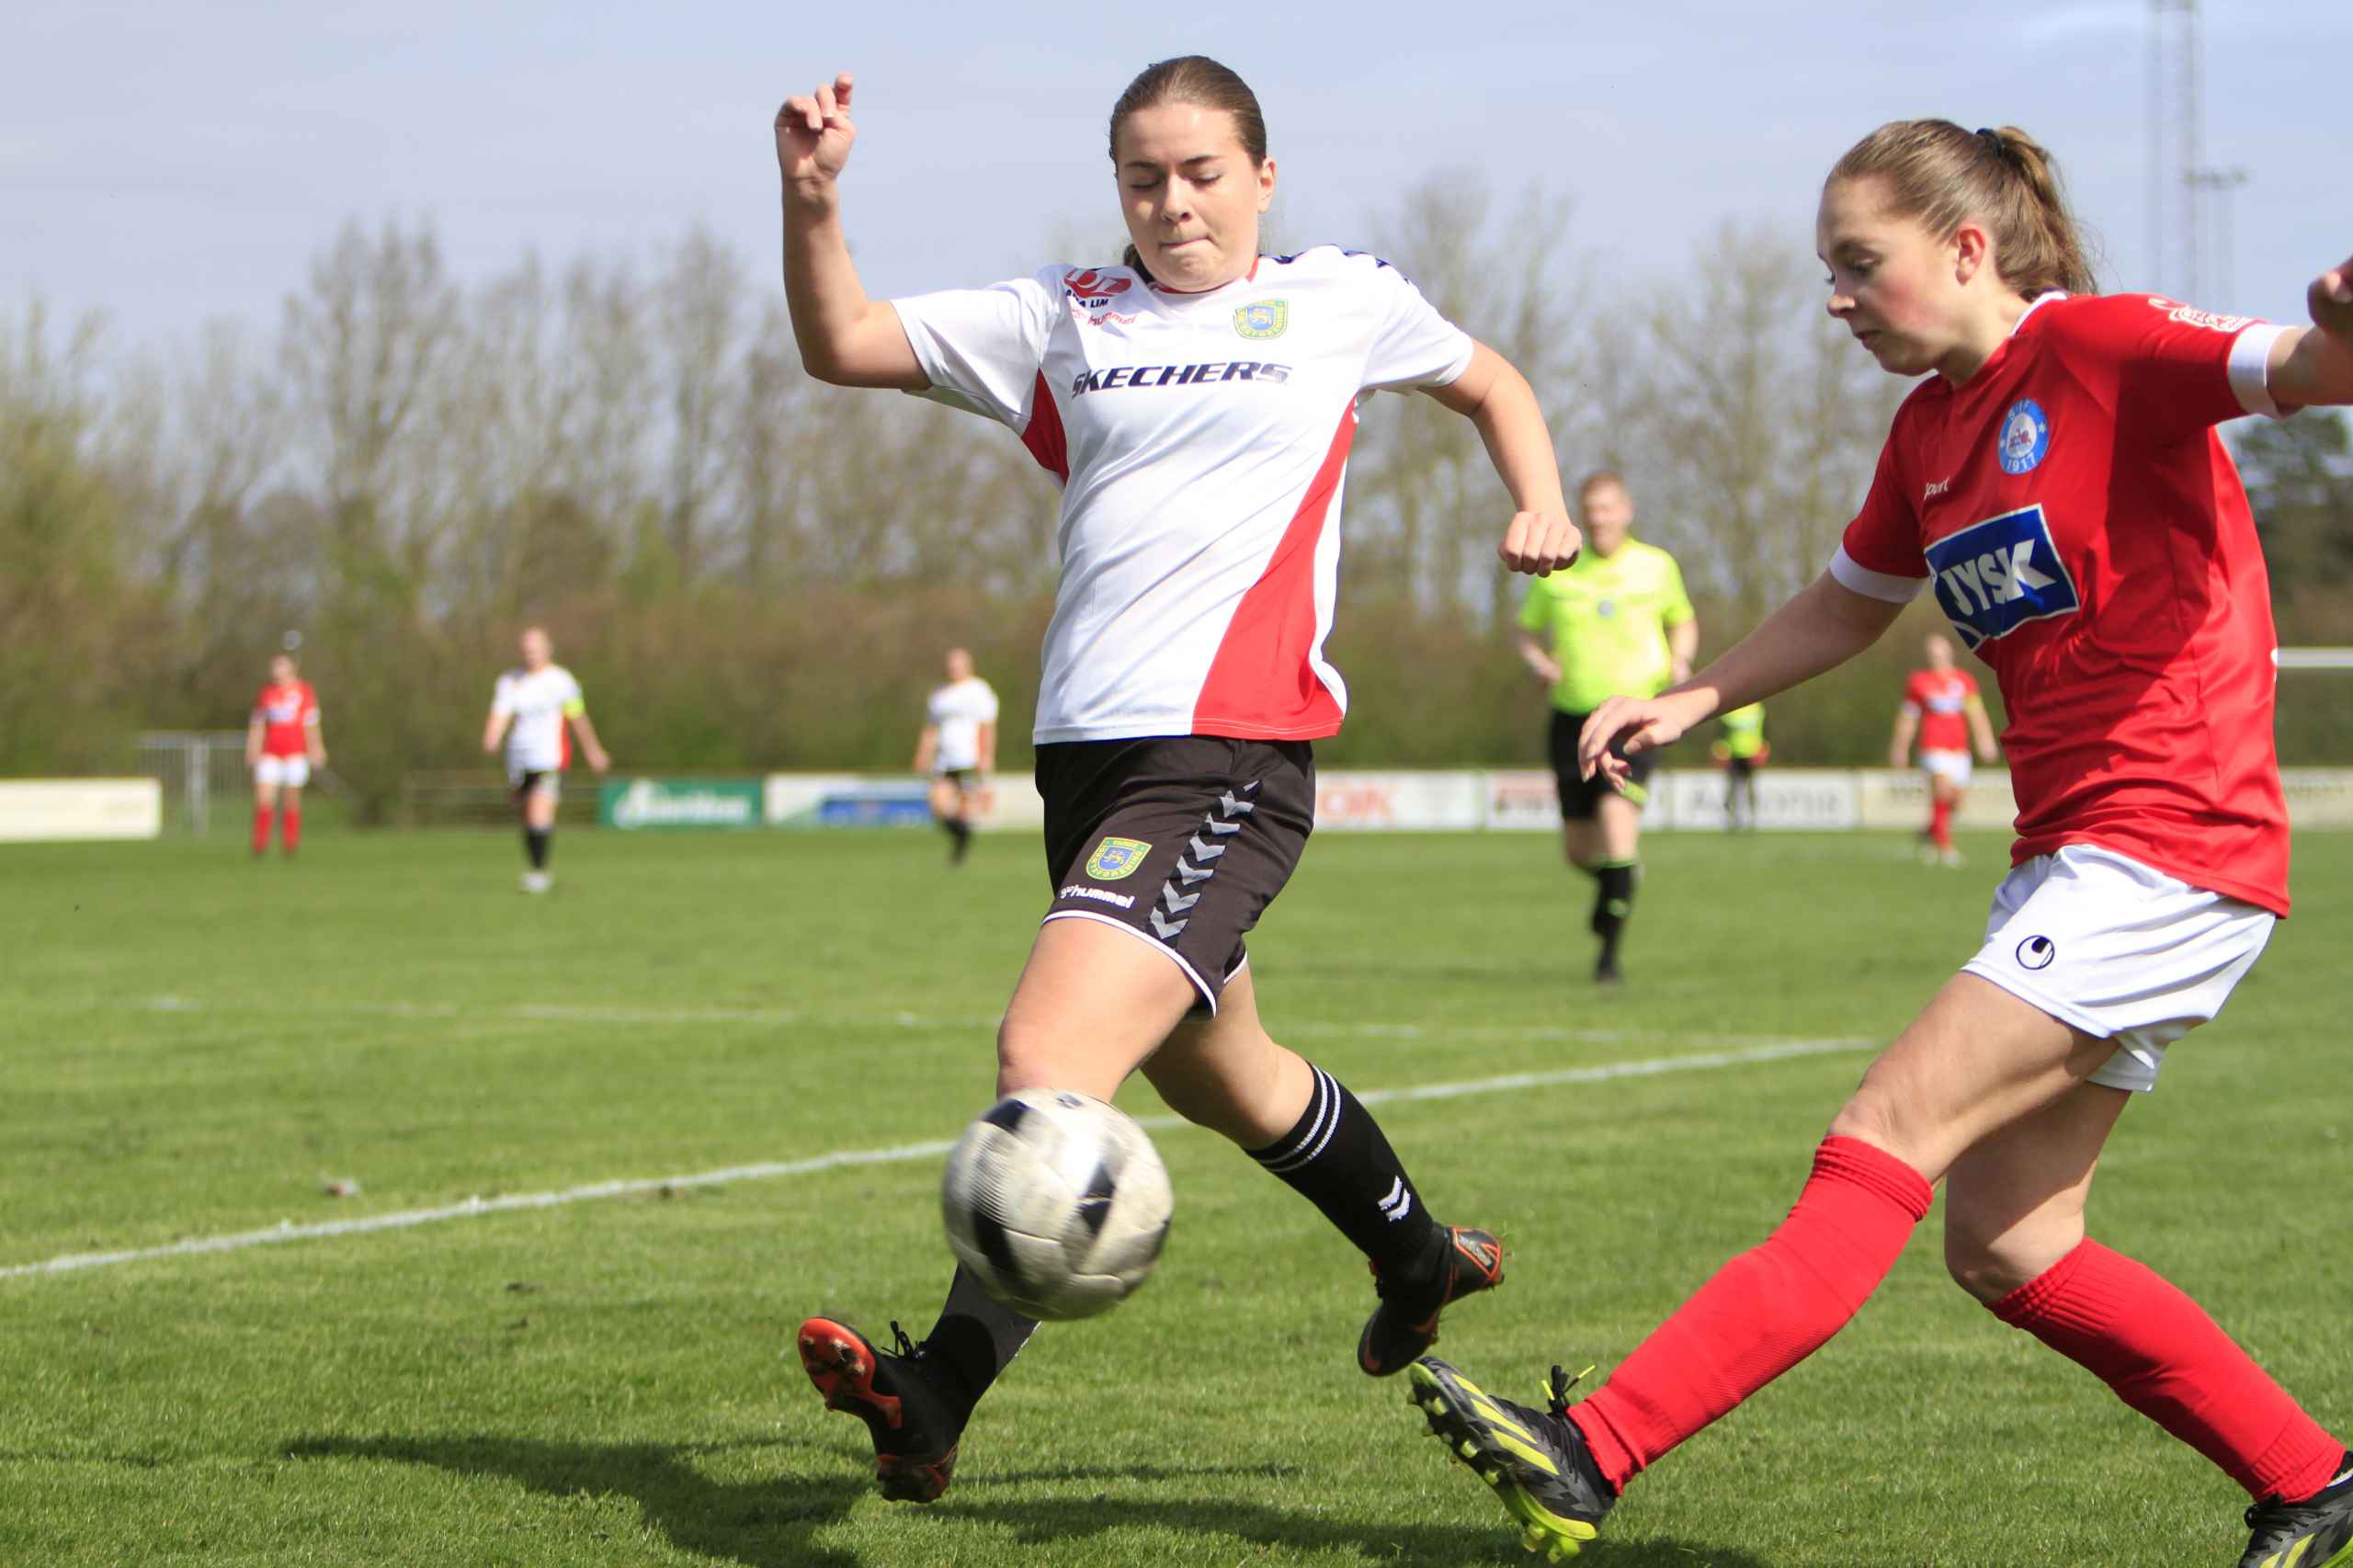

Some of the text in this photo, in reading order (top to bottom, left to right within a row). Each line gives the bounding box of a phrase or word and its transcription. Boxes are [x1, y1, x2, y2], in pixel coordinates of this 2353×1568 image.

[1072, 361, 1292, 398] SKECHERS
[2007, 452, 2036, 472] 1917
[1939, 538, 2058, 617] JYSK
